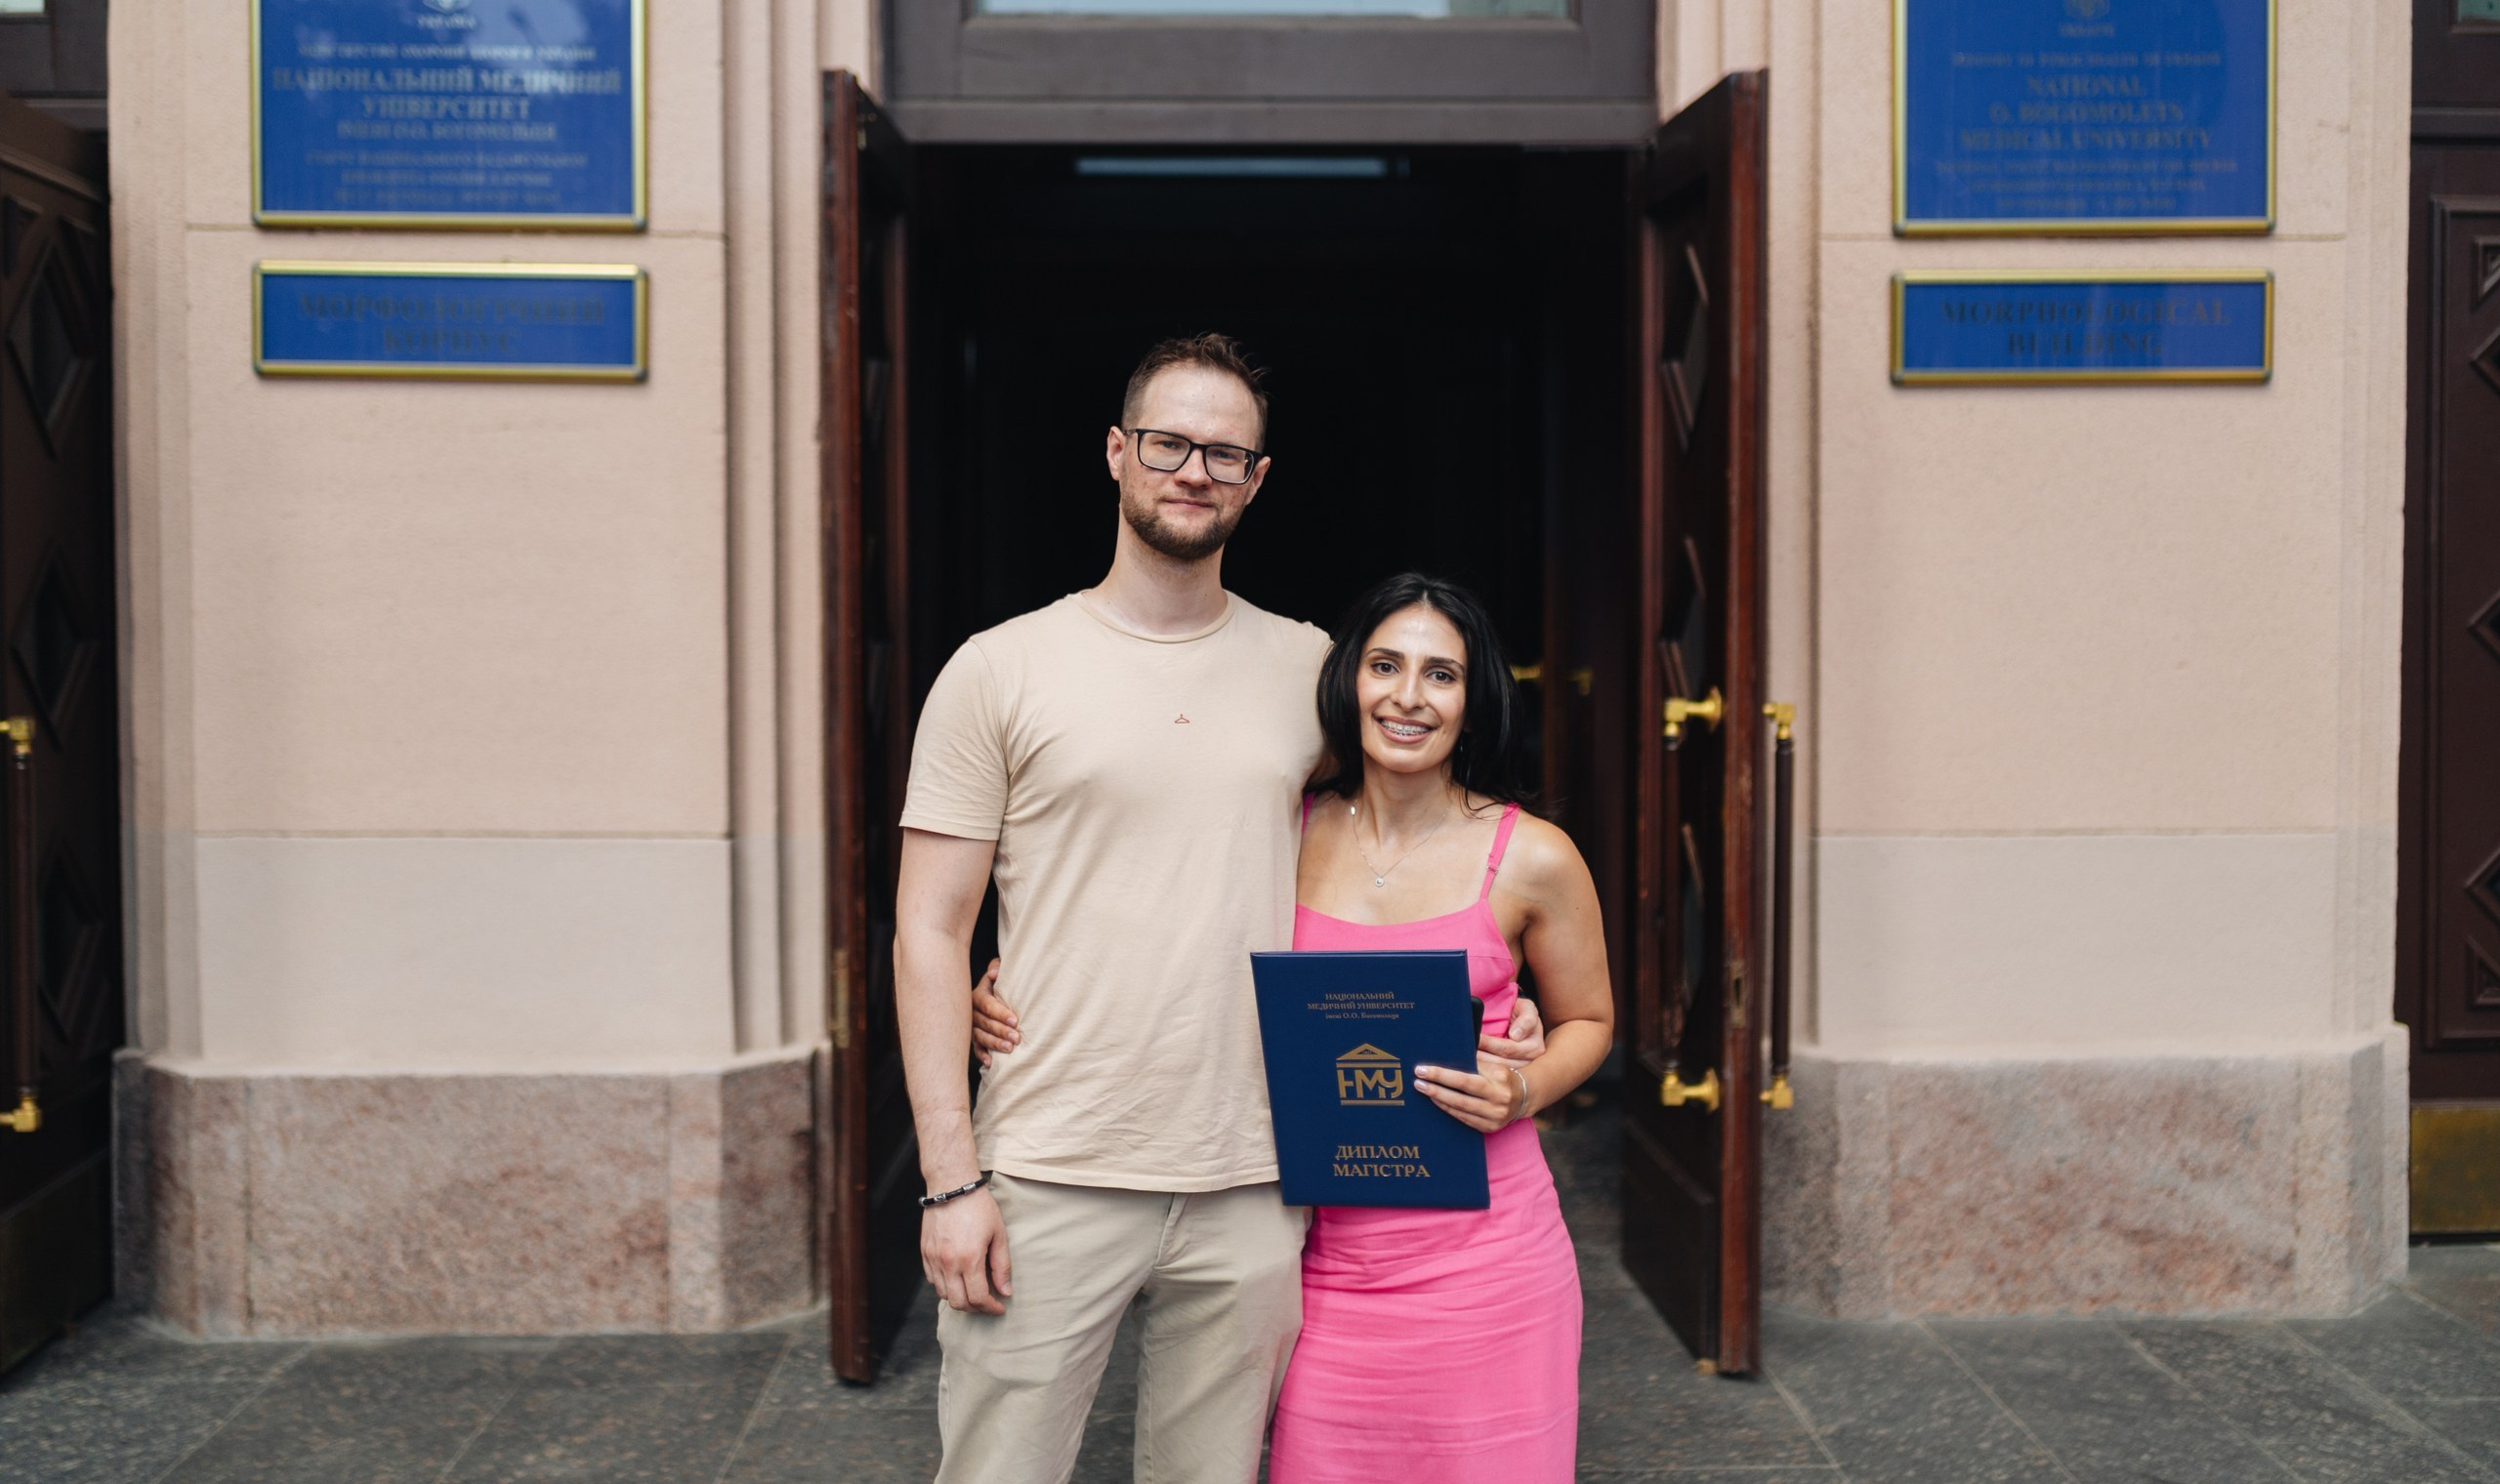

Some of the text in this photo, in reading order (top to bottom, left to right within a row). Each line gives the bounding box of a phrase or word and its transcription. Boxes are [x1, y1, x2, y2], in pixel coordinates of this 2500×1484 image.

[2026, 74, 2146, 97] NATIONAL
[362, 96, 530, 119] УНІВЕРСИТЕТ
[2018, 102, 2185, 123] BOGOMOLETS
[1959, 127, 2210, 150] MEDICAL UNIVERSITY
[1939, 297, 2232, 326] MORPHOLOGICAL
[382, 325, 522, 356] КОРПУС
[2006, 331, 2164, 357] BUILDING
[1307, 1002, 1356, 1010] МЕДИЧНИЙ
[1325, 991, 1395, 1002] НАЦІОНАЛЬНИЙ
[1334, 1145, 1421, 1161] ДИПЛОМ
[1332, 1163, 1431, 1177] МАГІСТРА
